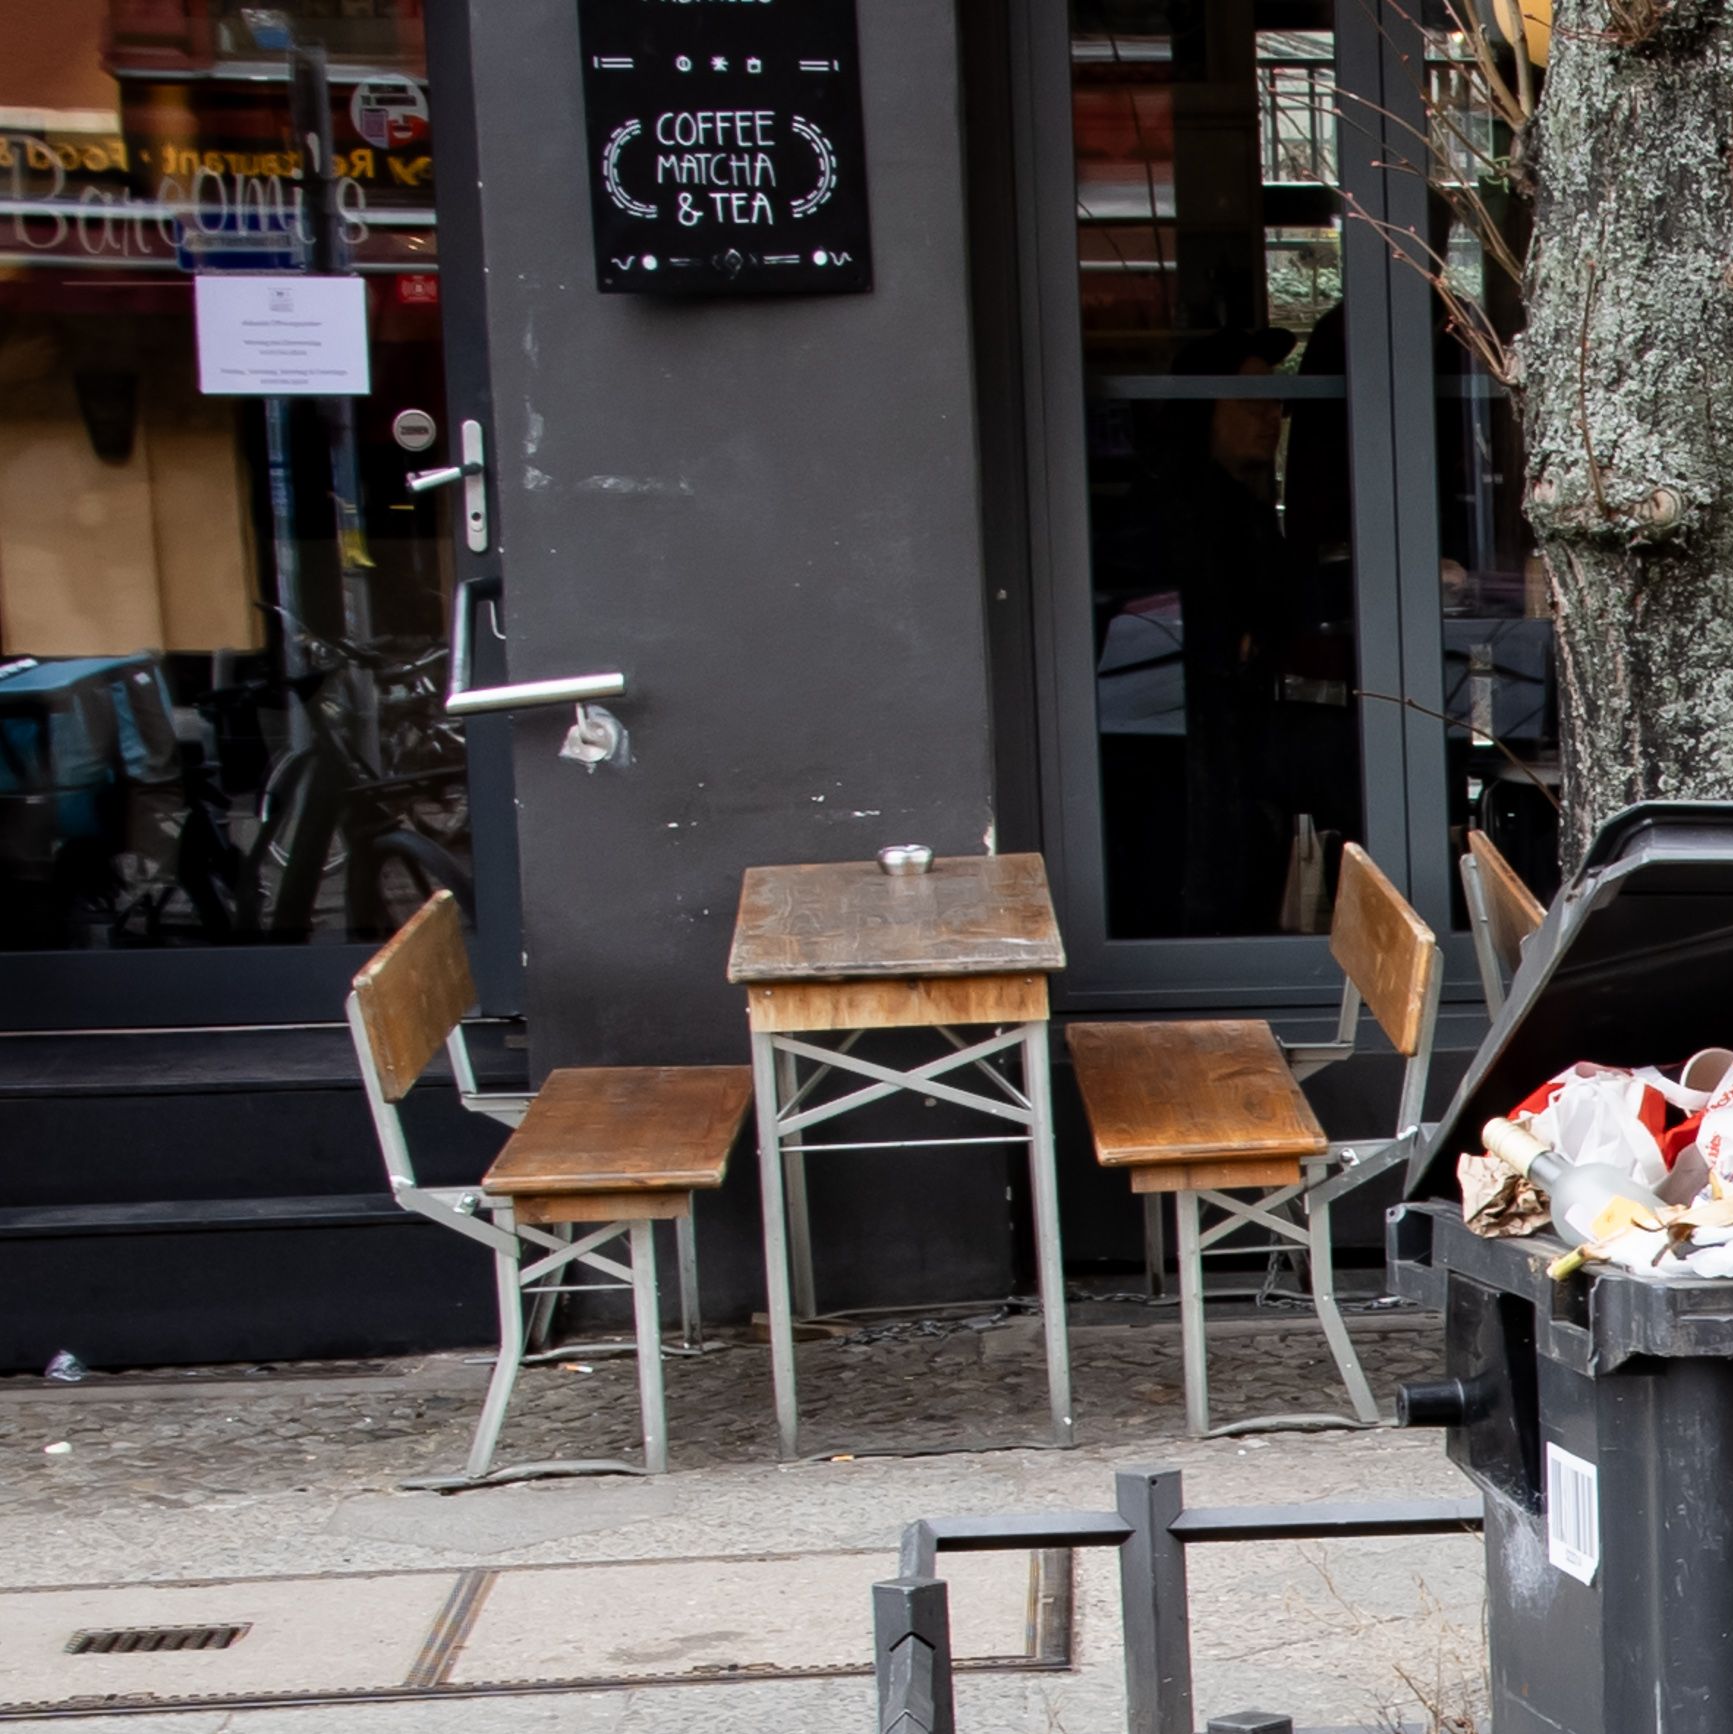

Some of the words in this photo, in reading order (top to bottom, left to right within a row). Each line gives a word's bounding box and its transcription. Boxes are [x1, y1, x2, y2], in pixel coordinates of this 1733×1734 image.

[656, 111, 776, 146] COFFEE
[657, 153, 777, 188] MATCHA
[677, 192, 704, 227] &
[708, 192, 774, 226] TEA
